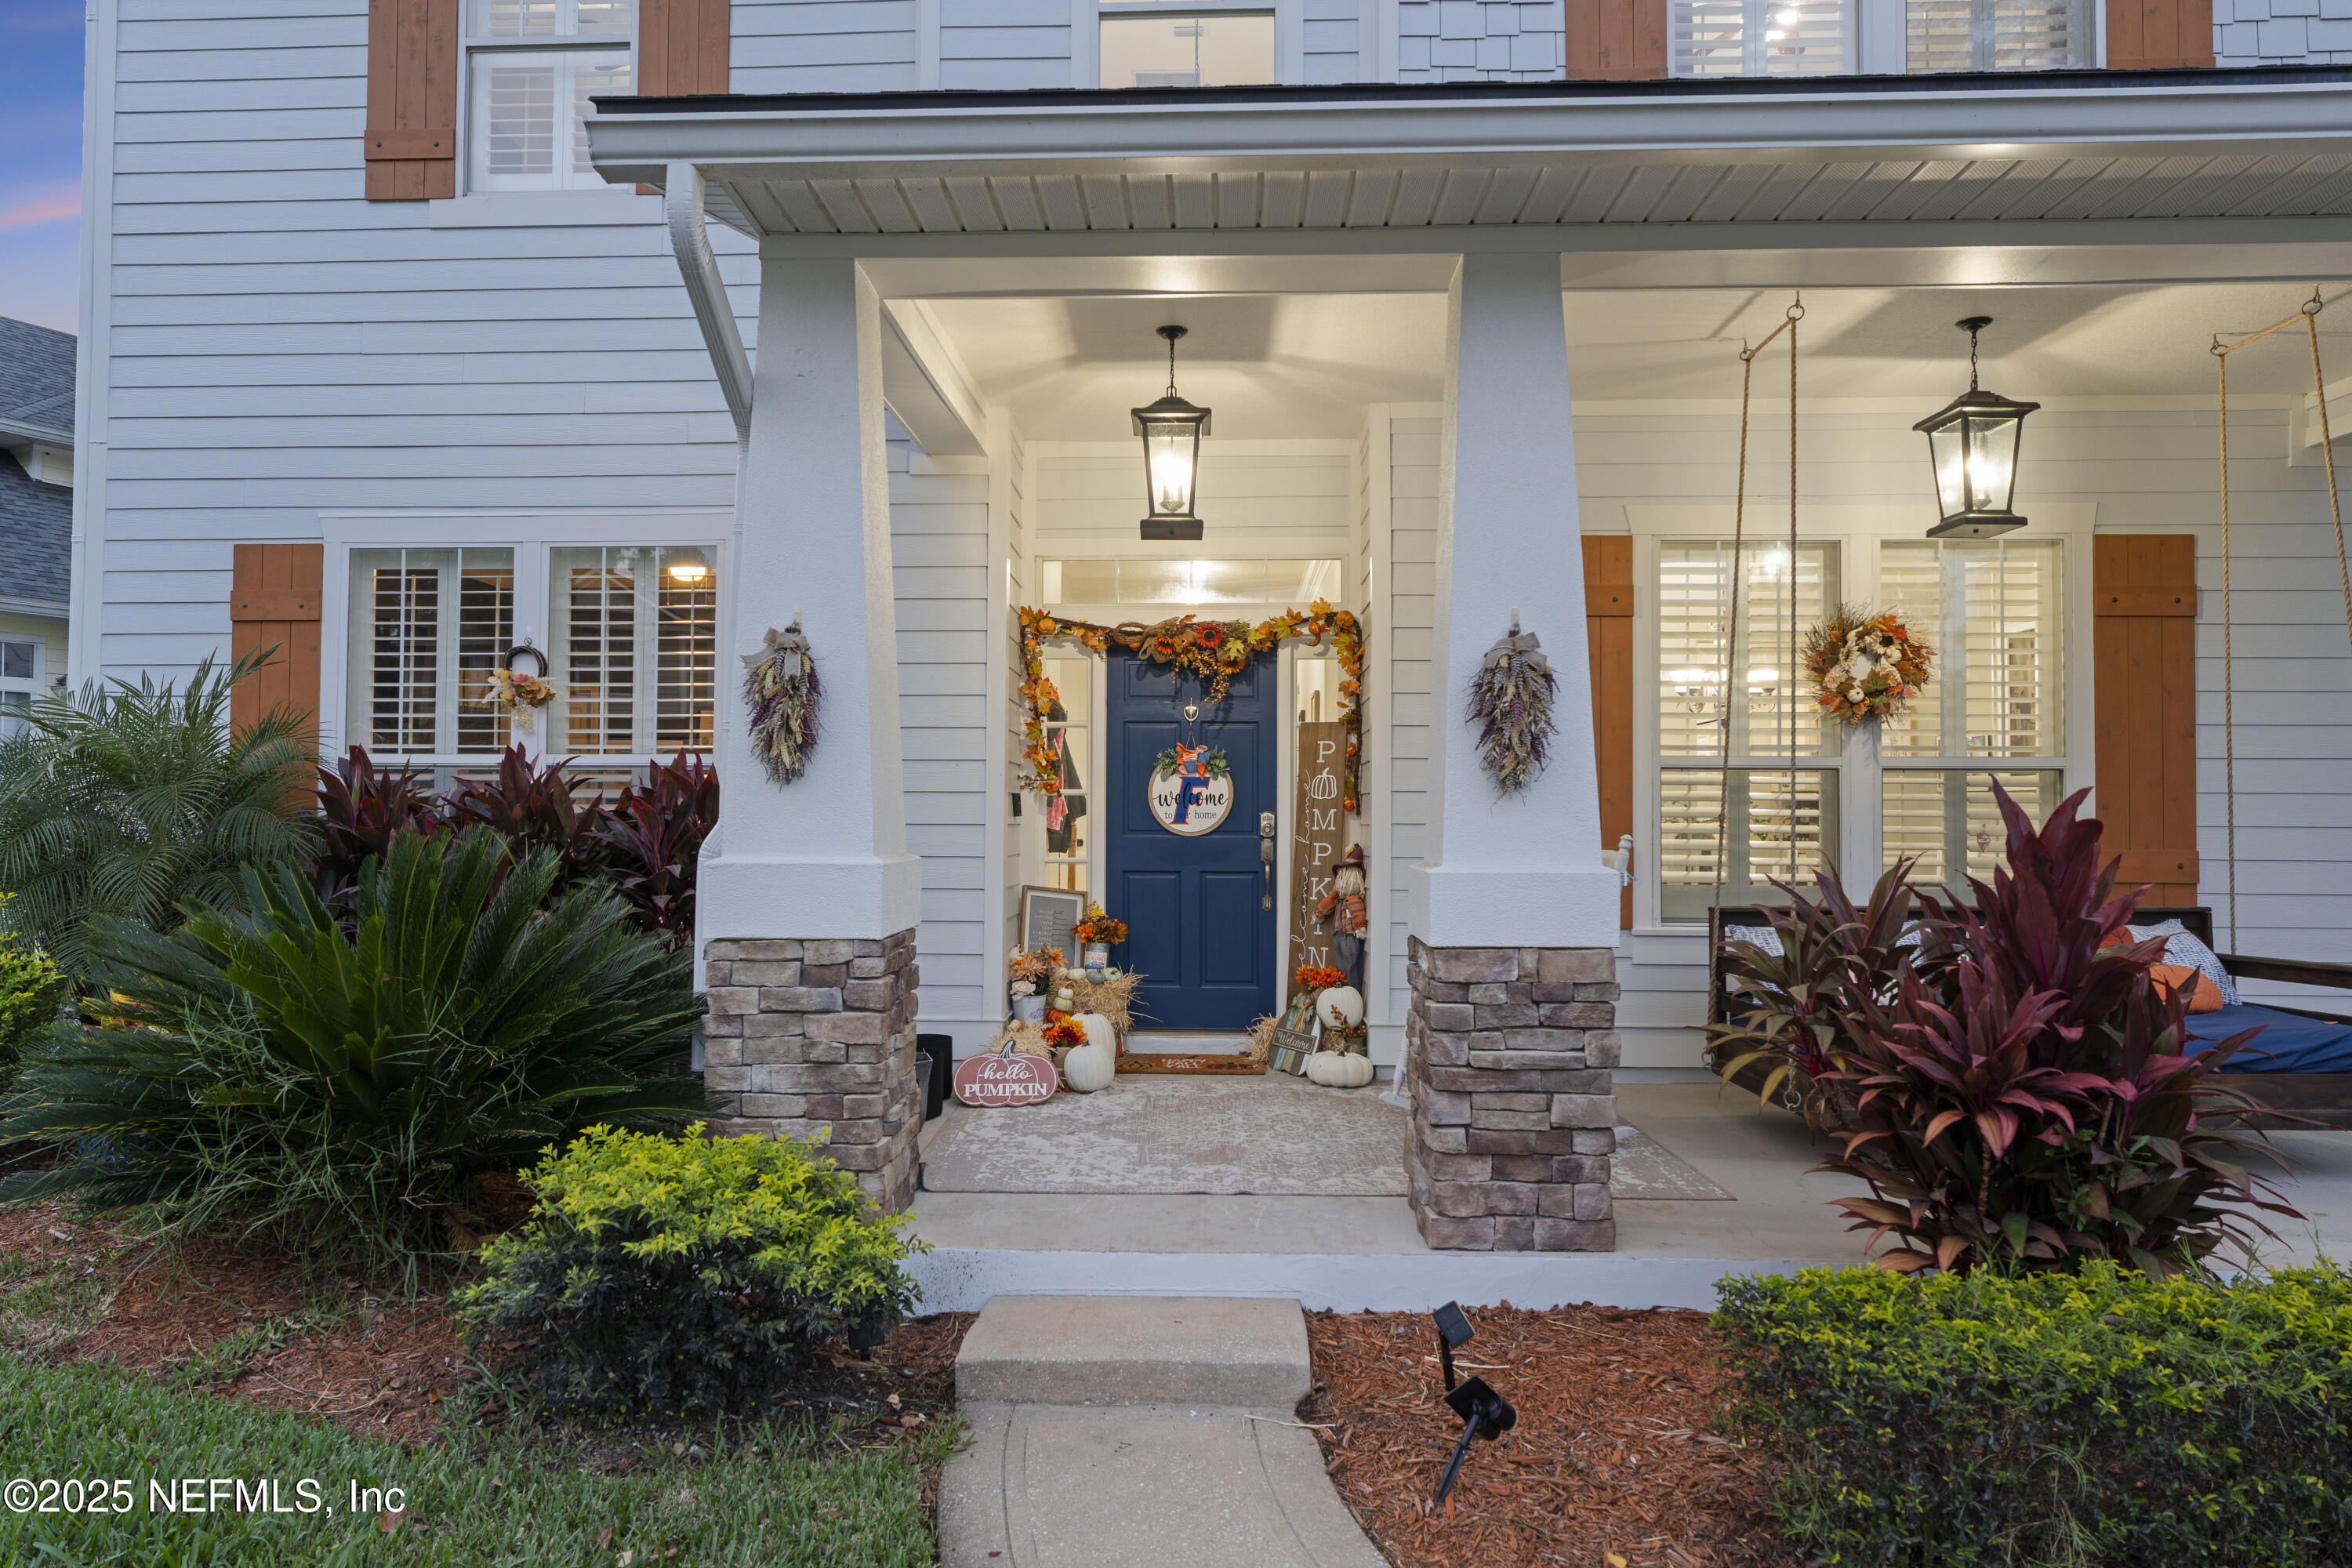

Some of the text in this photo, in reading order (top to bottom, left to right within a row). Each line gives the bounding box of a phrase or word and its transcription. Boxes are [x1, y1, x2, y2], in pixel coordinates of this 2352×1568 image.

[1152, 782, 1229, 809] welcome
[1168, 777, 1211, 825] F
[1194, 810, 1217, 819] home
[1290, 770, 1311, 970] elcome home
[1278, 1031, 1310, 1050] Welcome
[978, 1062, 1033, 1080] hello
[964, 1083, 1047, 1097] PUMPKIN
